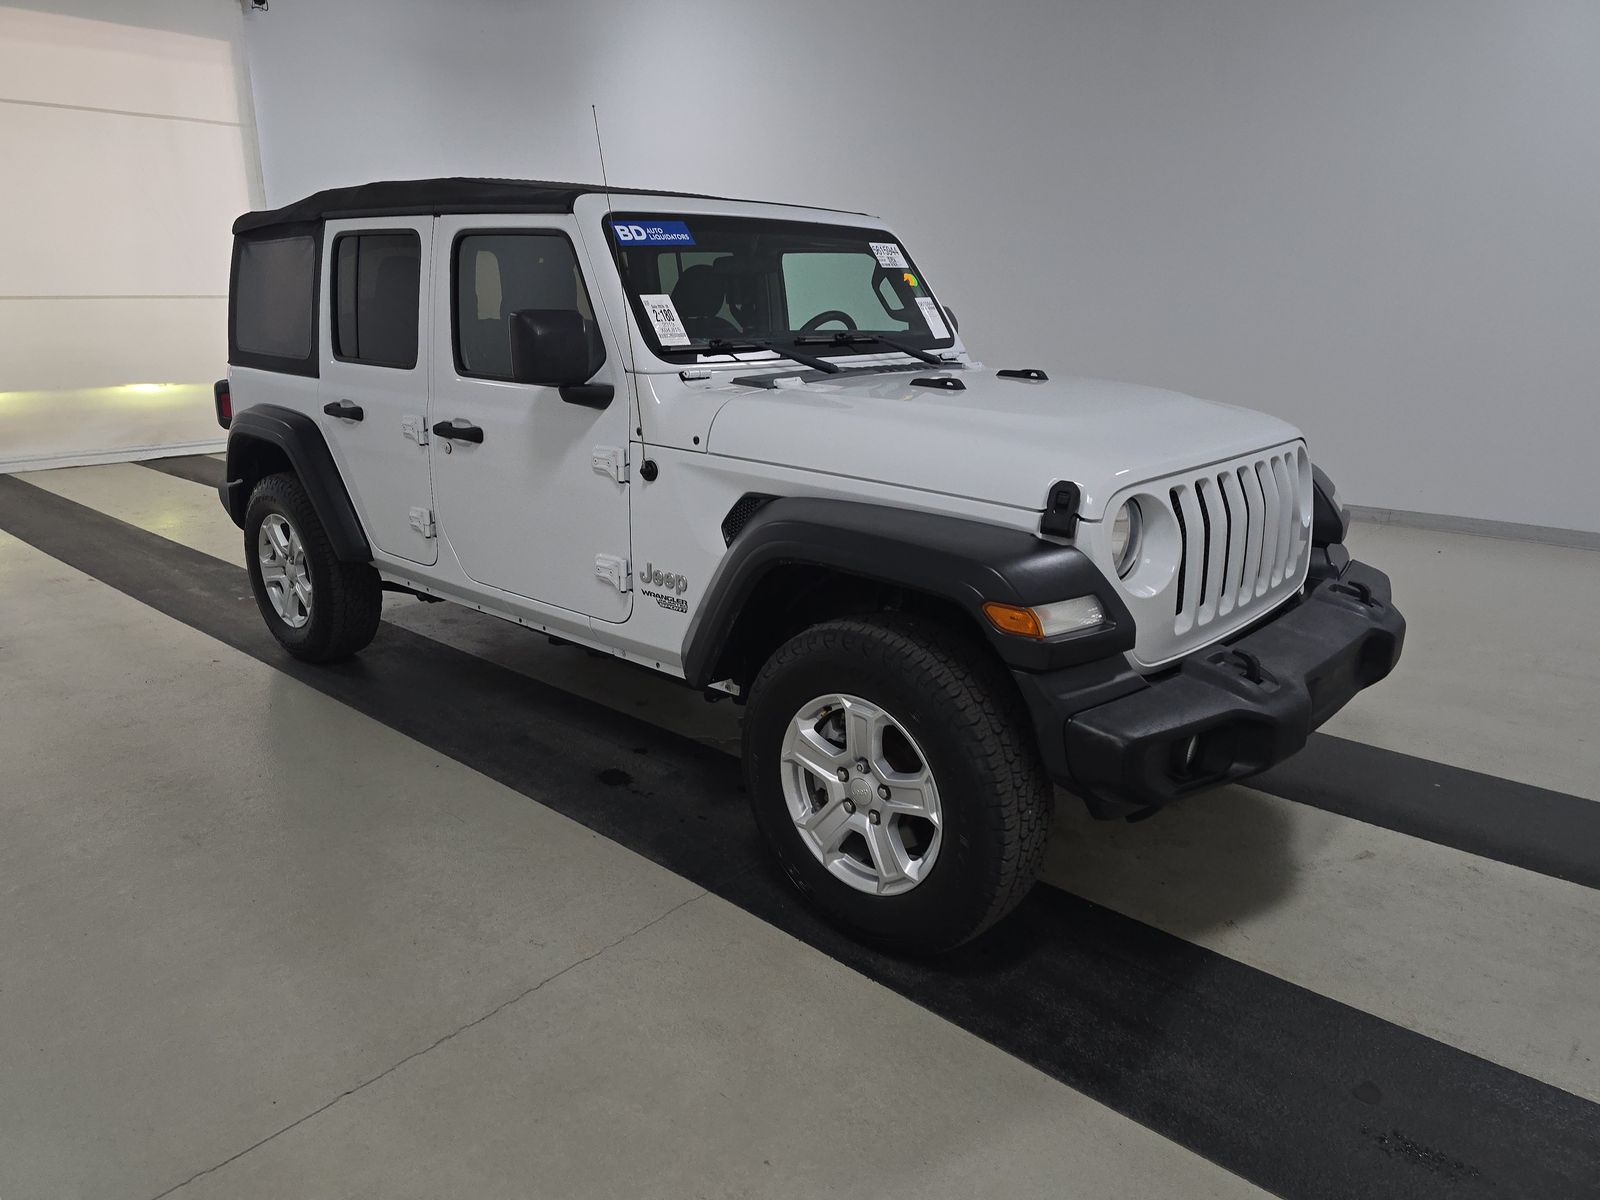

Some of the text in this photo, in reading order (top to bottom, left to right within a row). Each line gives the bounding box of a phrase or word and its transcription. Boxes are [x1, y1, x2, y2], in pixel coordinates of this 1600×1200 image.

[614, 225, 647, 241] BD
[649, 233, 690, 241] LIQUIDATORS
[652, 308, 675, 322] 2:180
[639, 562, 688, 596] Jeep
[641, 588, 689, 606] WRANGLER
